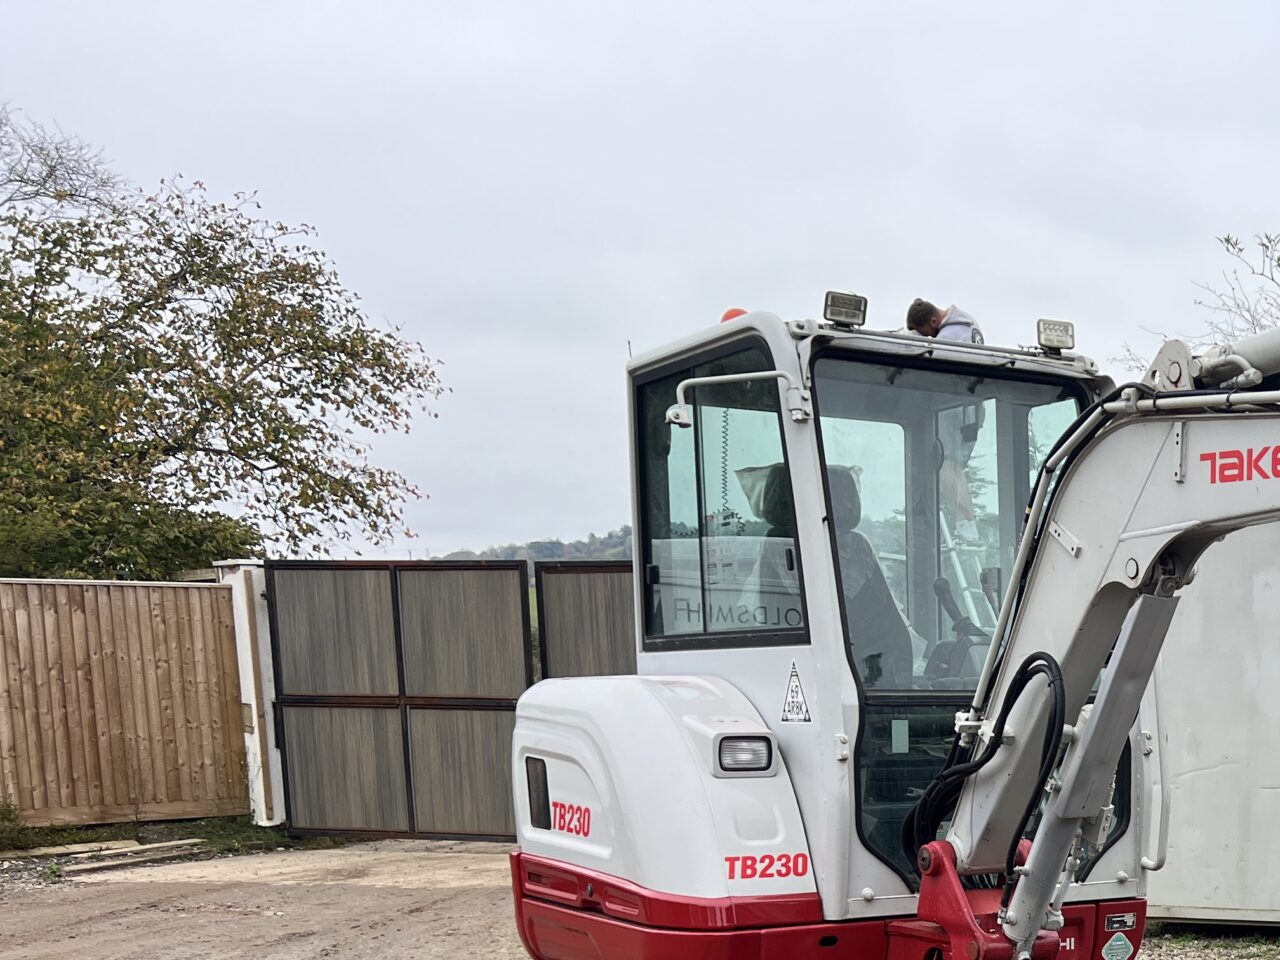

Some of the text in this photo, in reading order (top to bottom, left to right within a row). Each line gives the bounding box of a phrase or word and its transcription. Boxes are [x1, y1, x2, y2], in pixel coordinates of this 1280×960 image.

[790, 683, 799, 700] 69
[552, 801, 591, 837] TB230
[724, 852, 808, 880] TB230
